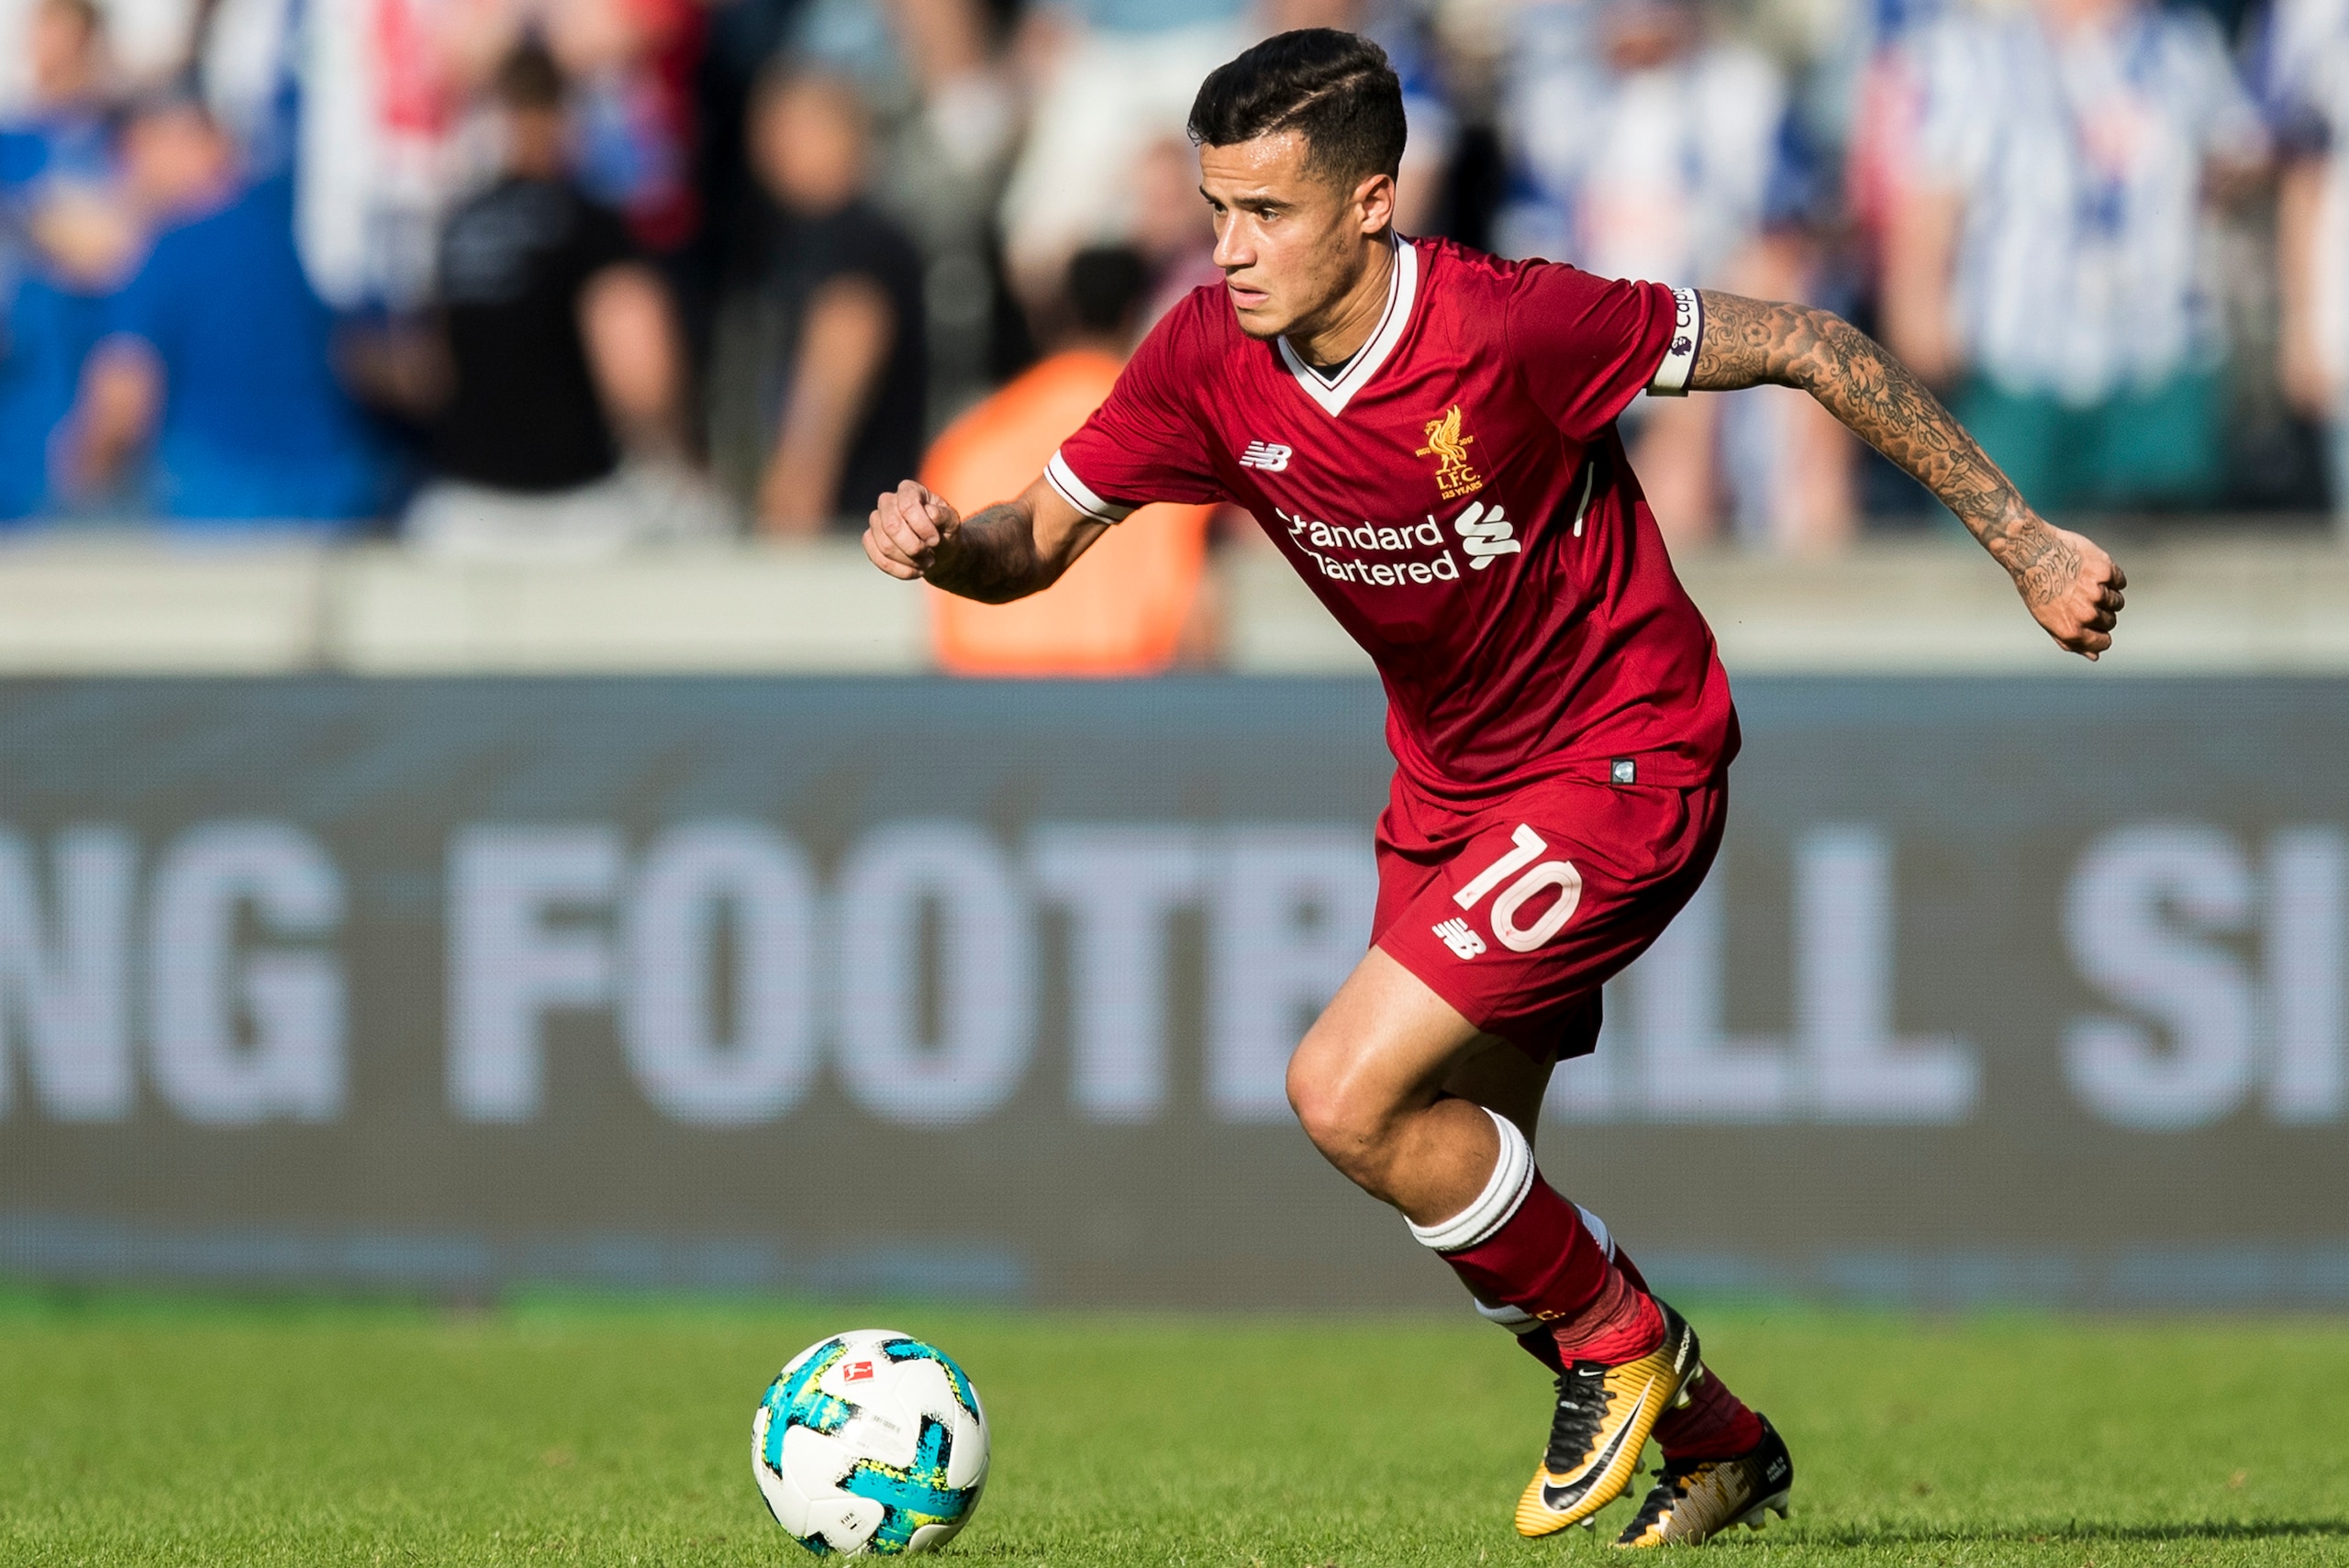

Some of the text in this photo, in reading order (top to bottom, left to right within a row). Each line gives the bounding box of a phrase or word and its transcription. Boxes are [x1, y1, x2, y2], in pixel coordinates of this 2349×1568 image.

[1436, 466, 1481, 490] L.F.C.
[1454, 480, 1483, 495] YEARS
[1452, 822, 1583, 953] 10
[448, 819, 1982, 1129] FOOTBLL
